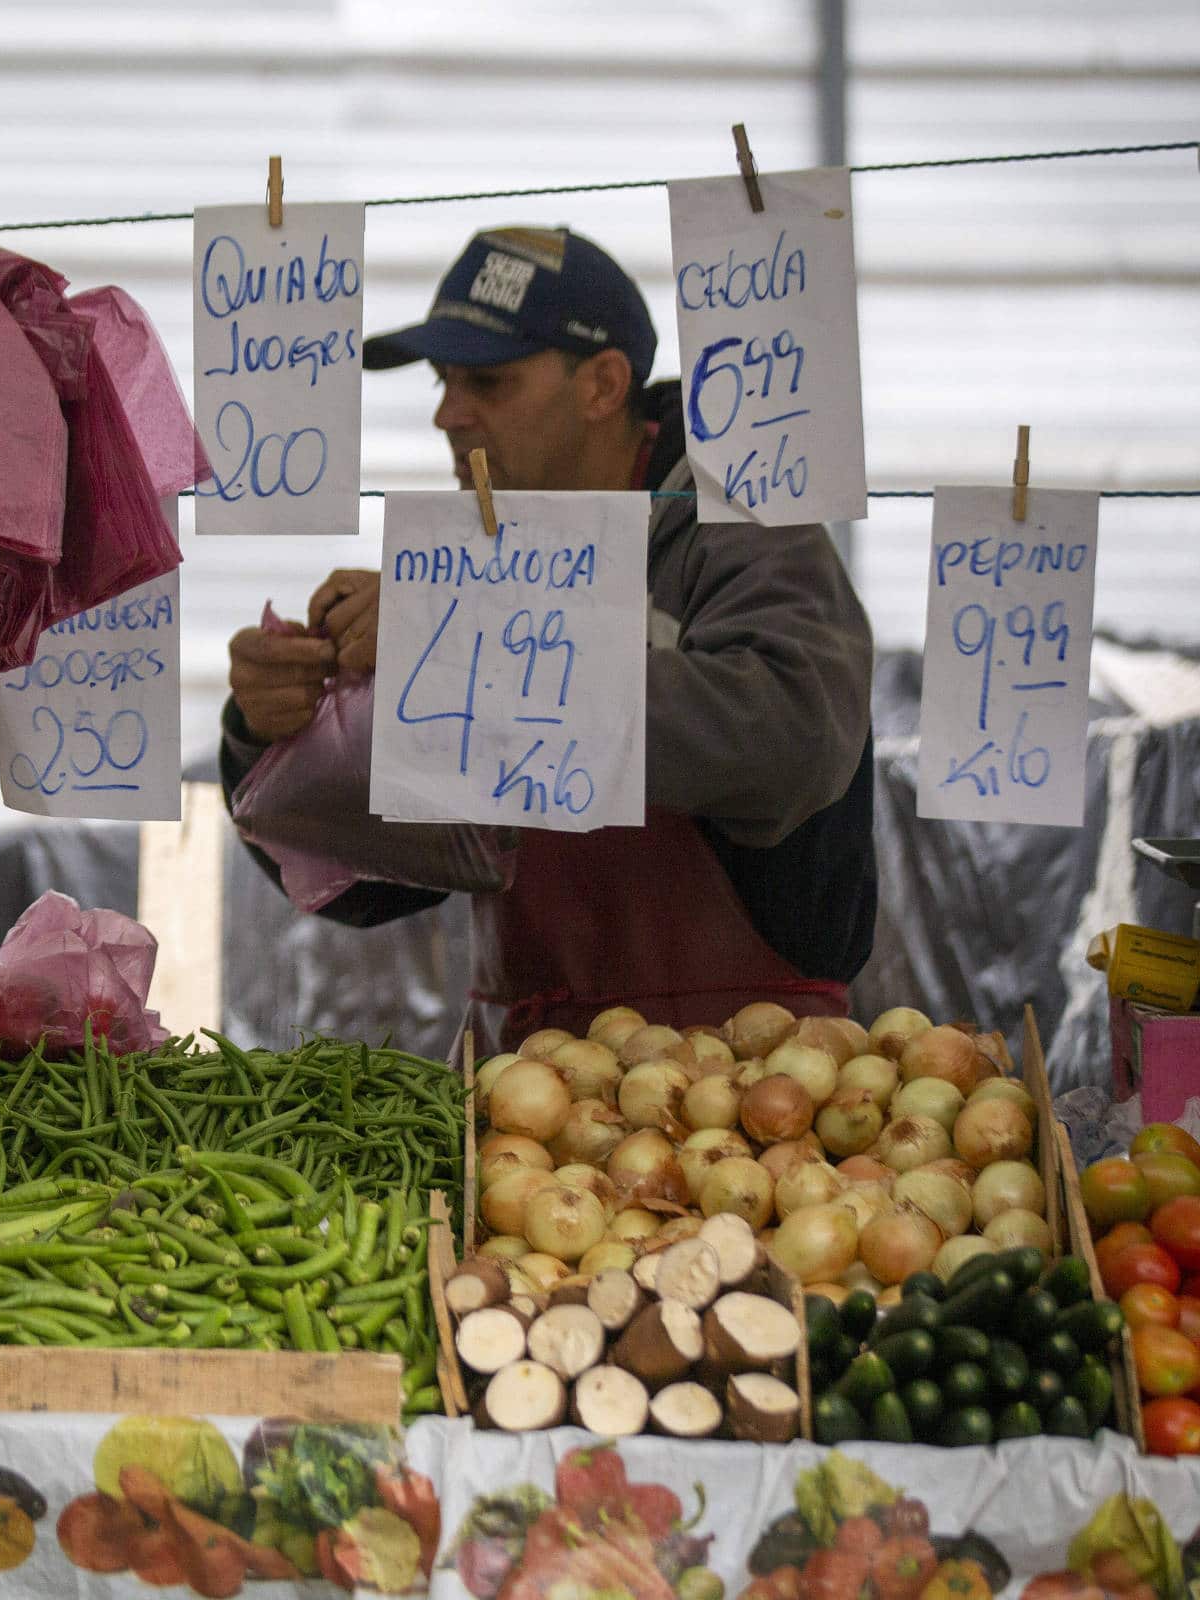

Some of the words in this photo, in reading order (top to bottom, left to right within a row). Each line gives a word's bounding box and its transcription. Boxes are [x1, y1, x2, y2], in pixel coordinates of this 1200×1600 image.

[688, 329, 805, 442] 6.99
[725, 434, 809, 508] Kilo
[397, 598, 575, 776] 4.99
[953, 601, 1069, 731] 9.99
[10, 706, 147, 795] 2.50
[492, 739, 594, 814] Kilo
[938, 711, 1050, 796] Kilo
